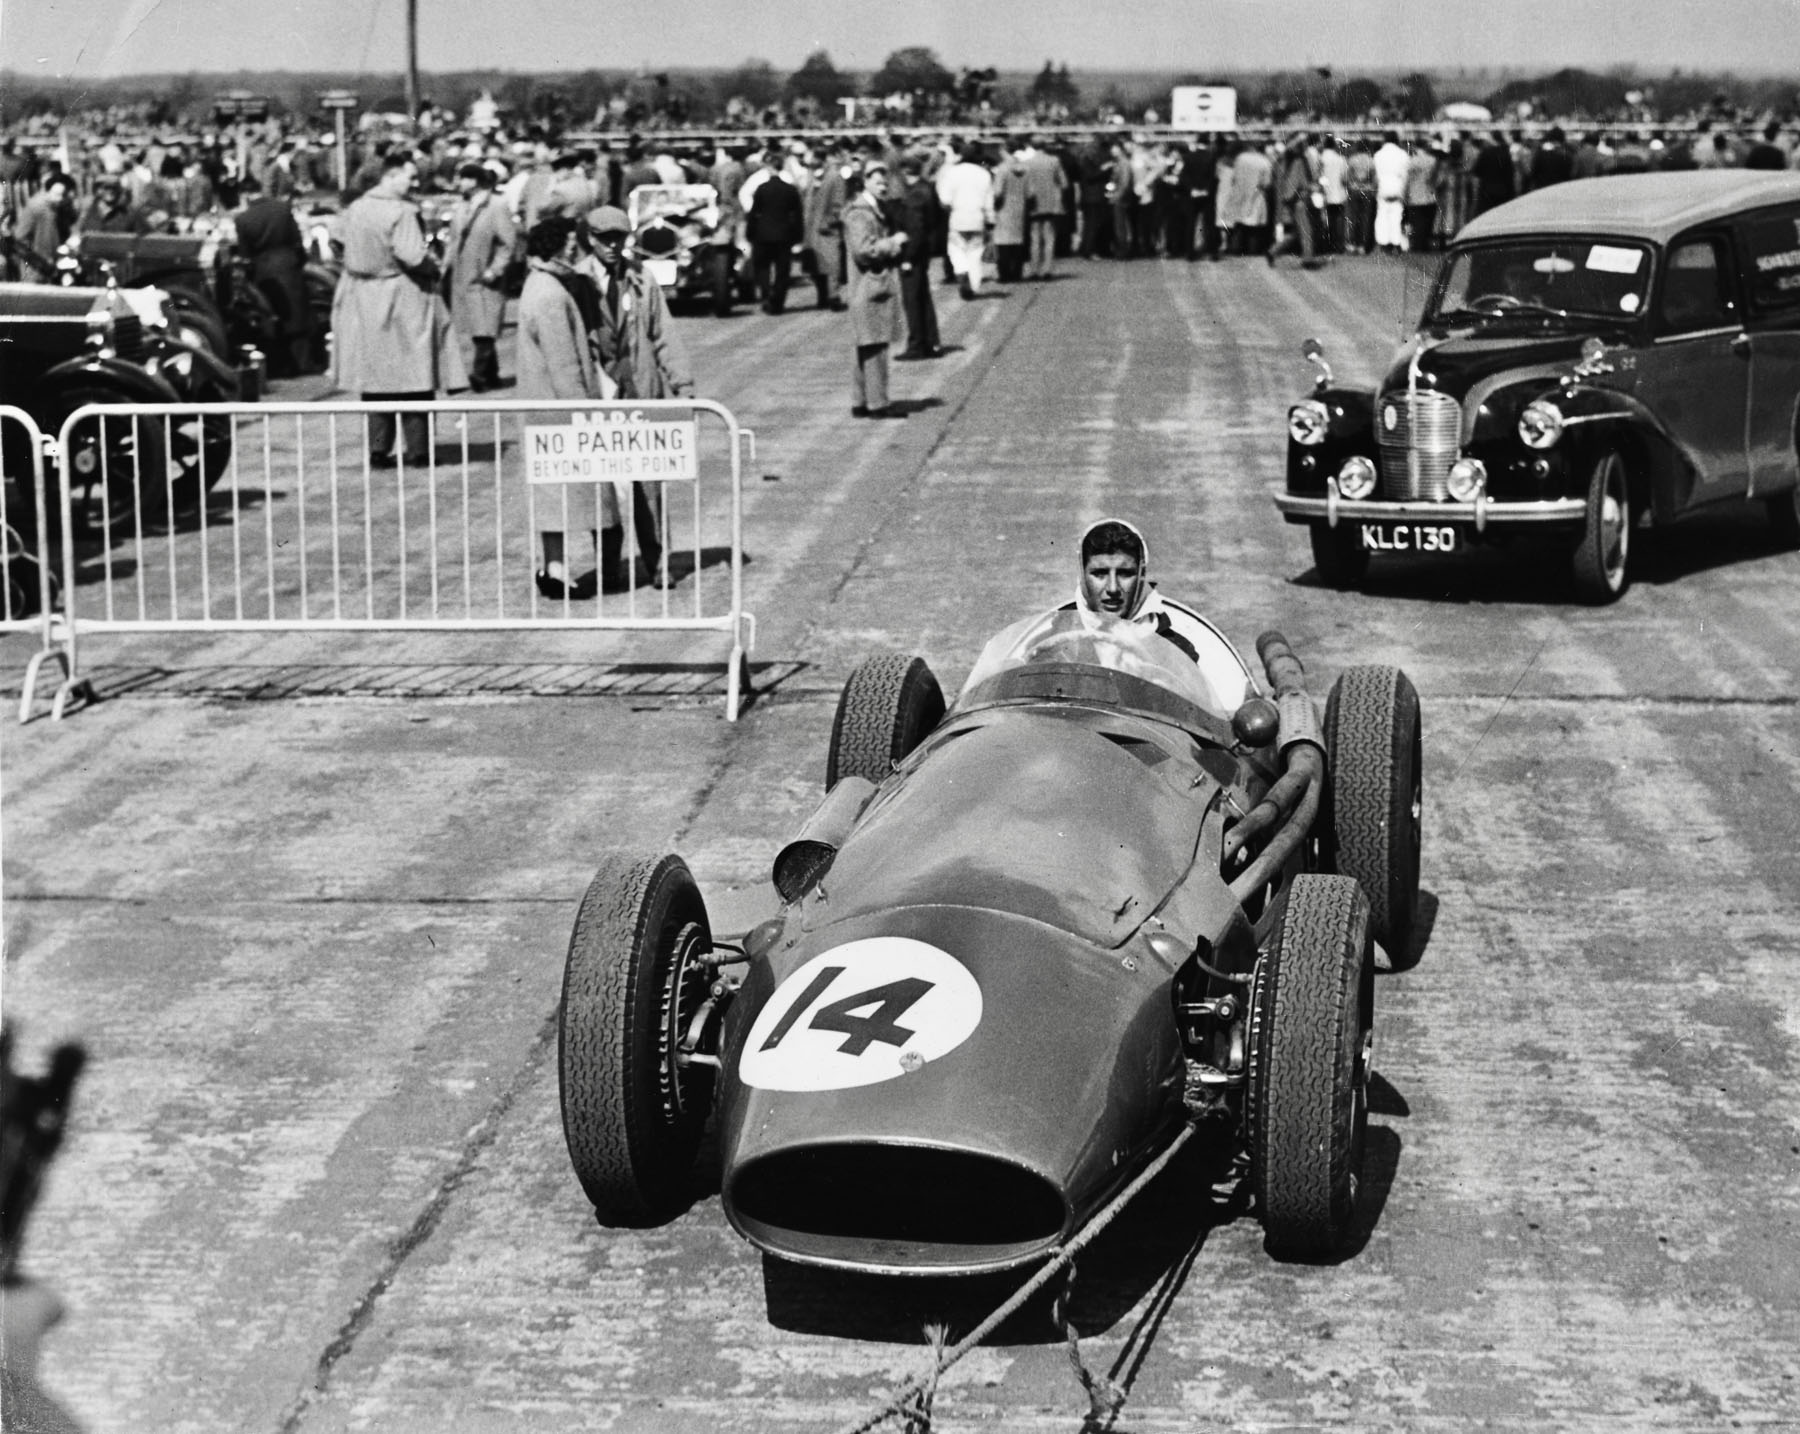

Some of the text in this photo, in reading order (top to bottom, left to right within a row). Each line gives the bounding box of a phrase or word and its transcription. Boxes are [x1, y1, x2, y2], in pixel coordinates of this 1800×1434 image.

[535, 428, 683, 454] NO PARKING
[534, 455, 687, 478] BEYOND THIS POINT
[1361, 524, 1455, 552] KLC 130
[758, 966, 937, 1057] 14
